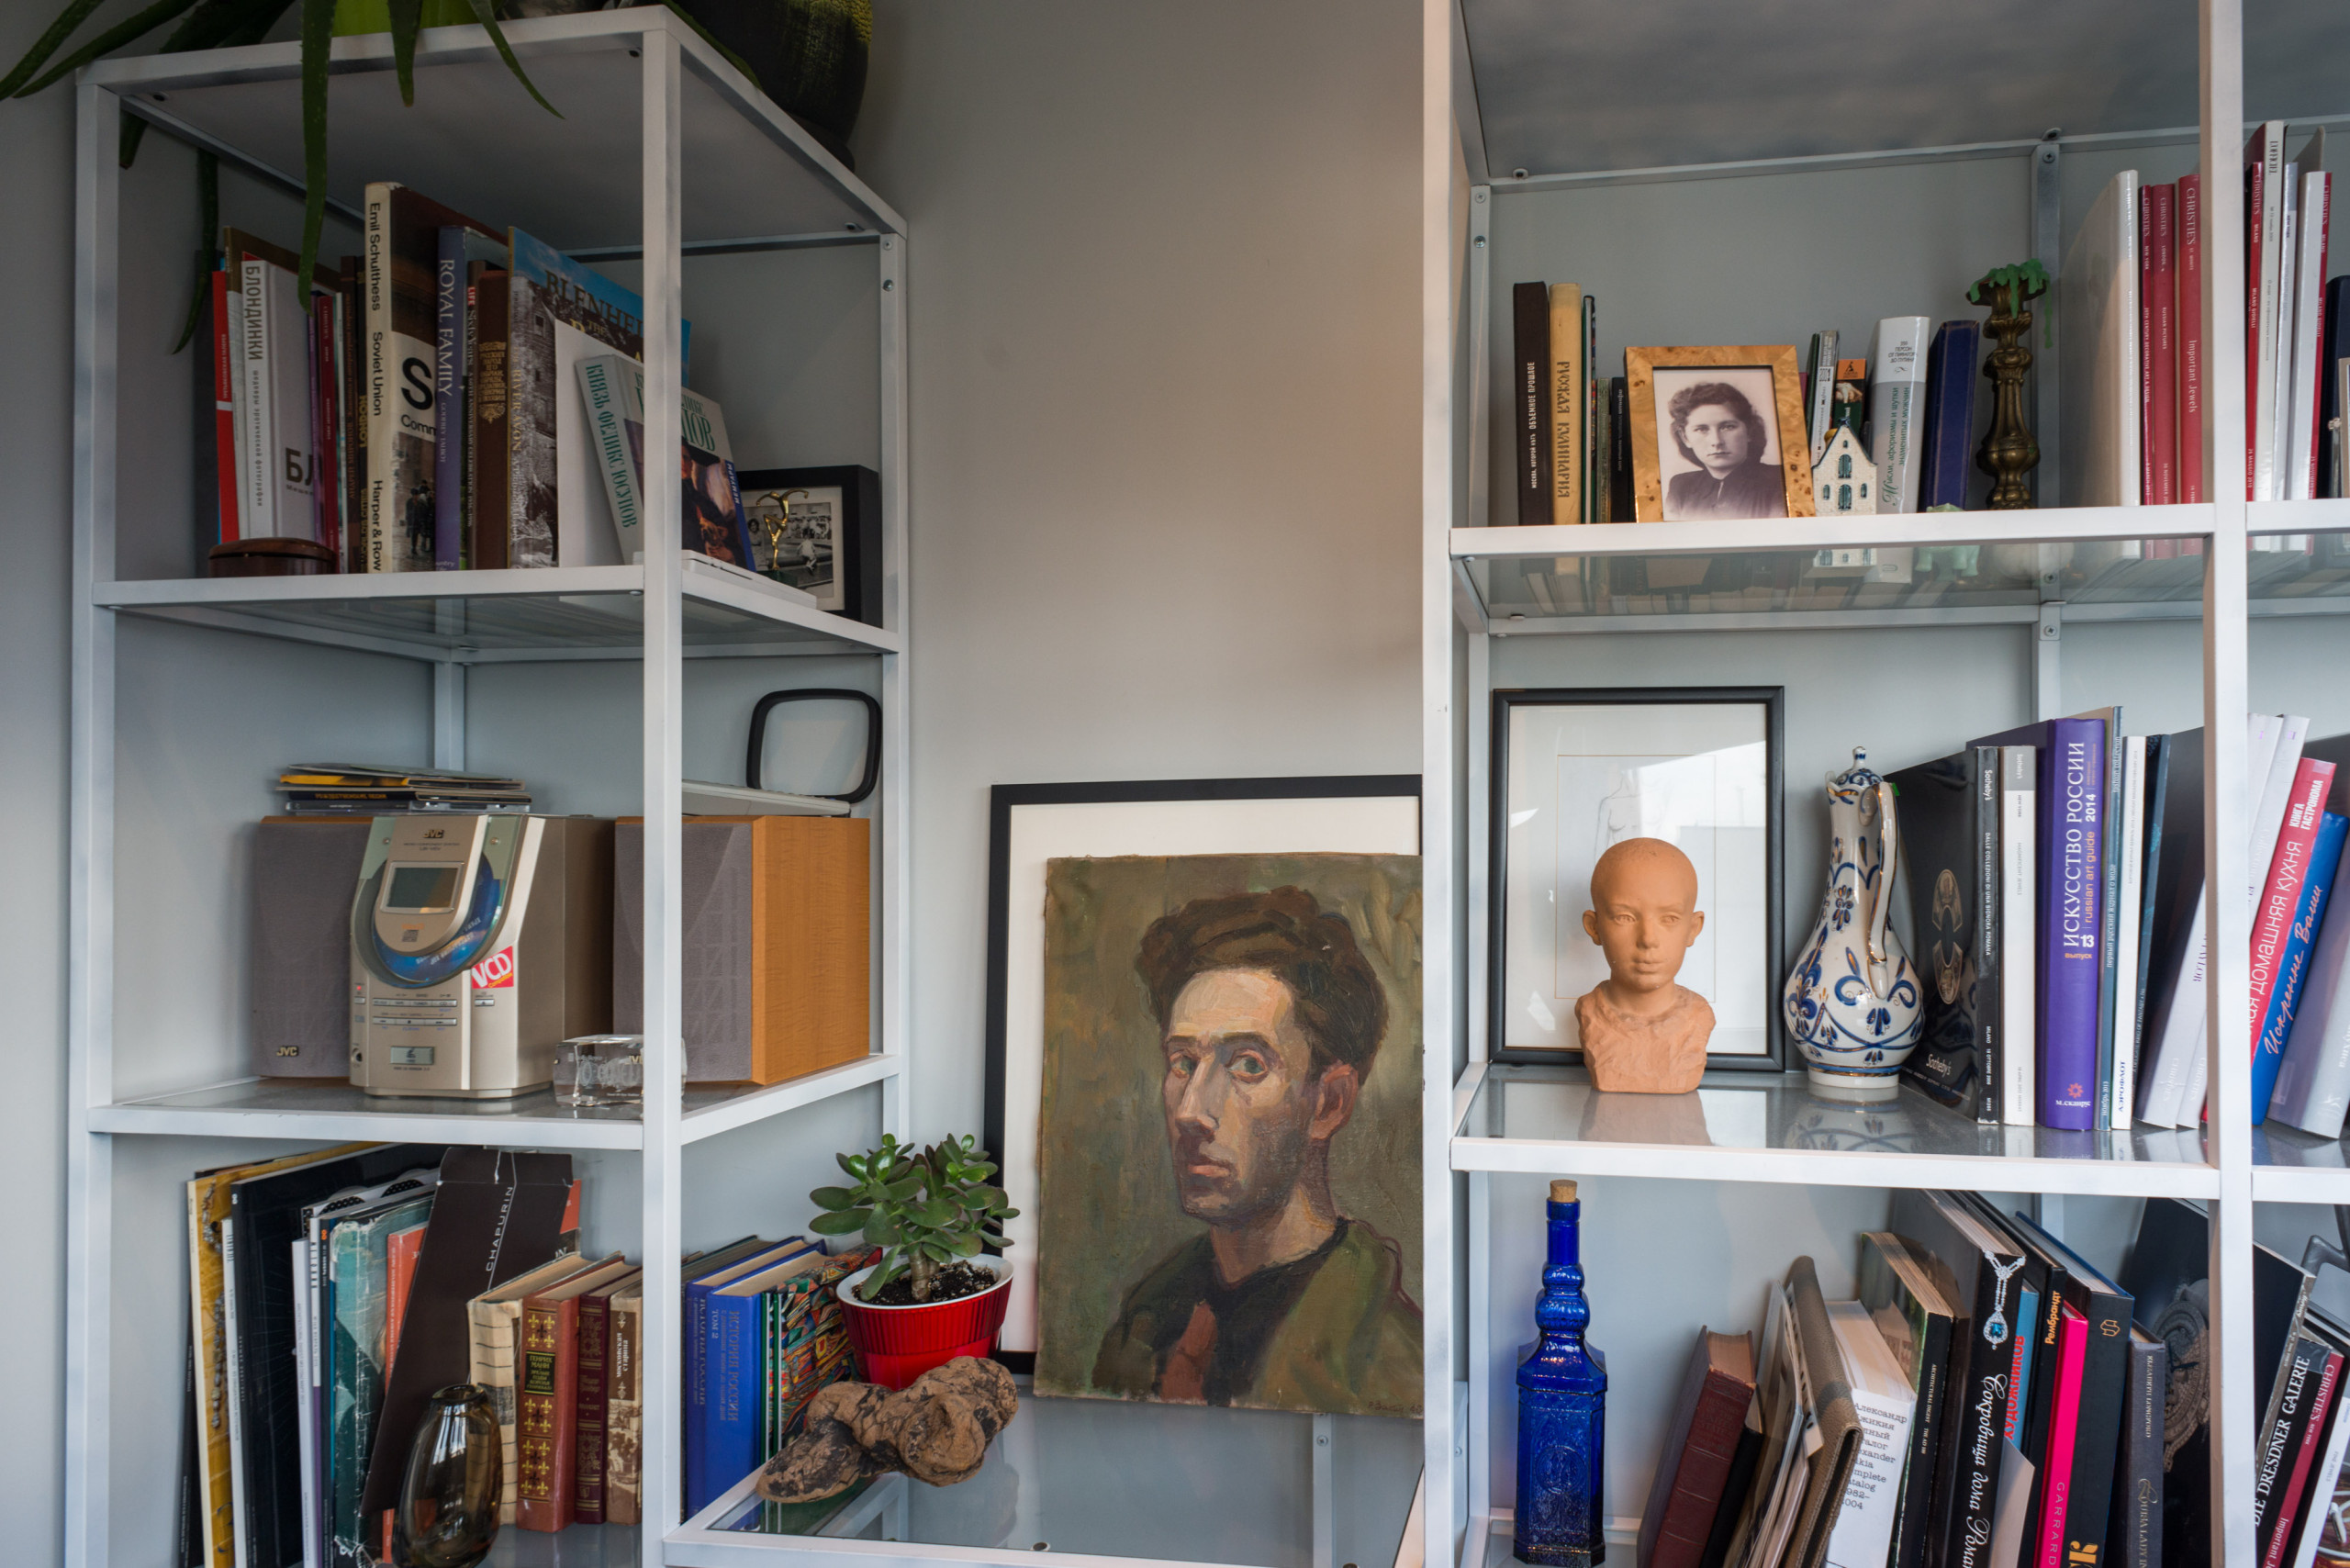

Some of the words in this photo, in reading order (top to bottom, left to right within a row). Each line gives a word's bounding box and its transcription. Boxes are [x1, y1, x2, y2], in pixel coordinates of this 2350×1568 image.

[2253, 174, 2262, 215] CHRISTIE'S
[369, 202, 381, 231] Emil
[2187, 187, 2197, 245] CHRISTIE'S
[369, 232, 382, 312] Schulthess
[439, 259, 455, 323] ROYAL
[244, 265, 263, 362] БЛОНДИНКИ
[467, 286, 476, 307] LIFE
[372, 331, 384, 375] Soviet
[437, 328, 453, 398] FAMILY
[2187, 341, 2198, 381] Important
[373, 375, 384, 417] Union
[513, 369, 521, 410] RIVER
[585, 364, 611, 410] КНЯЗЬ
[1527, 362, 1536, 394] ПРОШЛОЕ
[1557, 361, 1570, 414] РУССКАЯ
[1528, 394, 1537, 430] ОБЪЕМНОЕ
[1891, 386, 1900, 410] шутки
[1901, 386, 1910, 419] мужчин
[2188, 386, 2198, 414] Jewels
[513, 414, 521, 452] AVON
[597, 410, 625, 469] ФЕЛИКС
[1887, 419, 1898, 462] афоризмы
[1898, 420, 1908, 466] знаменитых
[1557, 421, 1571, 498] КУЛИНАРИЯ
[370, 479, 383, 526] Harper
[610, 470, 638, 529] ЮСУПОВ
[371, 530, 383, 543] &
[371, 544, 384, 572] Row
[2112, 735, 2121, 769] collection
[1983, 769, 1994, 801] Sotheby's
[2065, 741, 2086, 823] РОССИИ
[2111, 770, 2121, 793] fashion
[2085, 792, 2097, 823] 2014
[2288, 803, 2305, 828] КНИГА
[2300, 778, 2324, 831] ГАСТРОНОМА
[422, 829, 446, 840] JVC
[2085, 830, 2097, 863] guide
[2063, 829, 2084, 948] ИСКУССТВО
[2085, 865, 2095, 881] art
[2083, 883, 2094, 924] russian
[2109, 887, 2117, 913] журнал
[2253, 894, 2289, 996] домашняя
[2274, 840, 2305, 891] кухня
[2079, 935, 2095, 948] 13
[2108, 913, 2117, 942] русский
[472, 952, 512, 990] VCD
[2065, 951, 2093, 960] выпуск
[2106, 941, 2115, 968] первый
[2264, 949, 2305, 1055] Искренне
[276, 1047, 298, 1057] JVC
[1925, 1053, 1953, 1079] Sotheby's
[2100, 1093, 2109, 1116] Ноябрь
[2118, 1059, 2127, 1113] АЭРОФЛОТ
[486, 1185, 514, 1272] CHAPURIN
[711, 1331, 719, 1339] 2
[2043, 1290, 2062, 1345] Рембрандт
[529, 1355, 553, 1363] ГЕНРИХ
[728, 1310, 740, 1369] ИСТОРИЯ
[1927, 1363, 1938, 1404] ARCHITECTURAL
[2145, 1355, 2154, 1396] ELIZABETH
[2308, 1364, 2336, 1423] CHRISTIE'S
[727, 1372, 739, 1422] РОССИИ
[1853, 1405, 1908, 1425] Александр
[1924, 1404, 1932, 1424] DIGEST
[1971, 1373, 2009, 1466] Сокровища
[2144, 1397, 2153, 1439] LONGFORD
[2255, 1418, 2291, 1496] DRESDNER
[2280, 1355, 2311, 1416] GALERIE
[2307, 1423, 2315, 1433] NEW
[1921, 1438, 1929, 1446] AD
[2304, 1433, 2313, 1445] YORK
[2331, 1450, 2340, 1462] FINE
[1968, 1472, 1989, 1511] дома
[2324, 1462, 2337, 1483] JEWELS
[2047, 1481, 2065, 1565] GARRARD
[2267, 1517, 2290, 1560] Important
[2138, 1529, 2149, 1559] LADY
